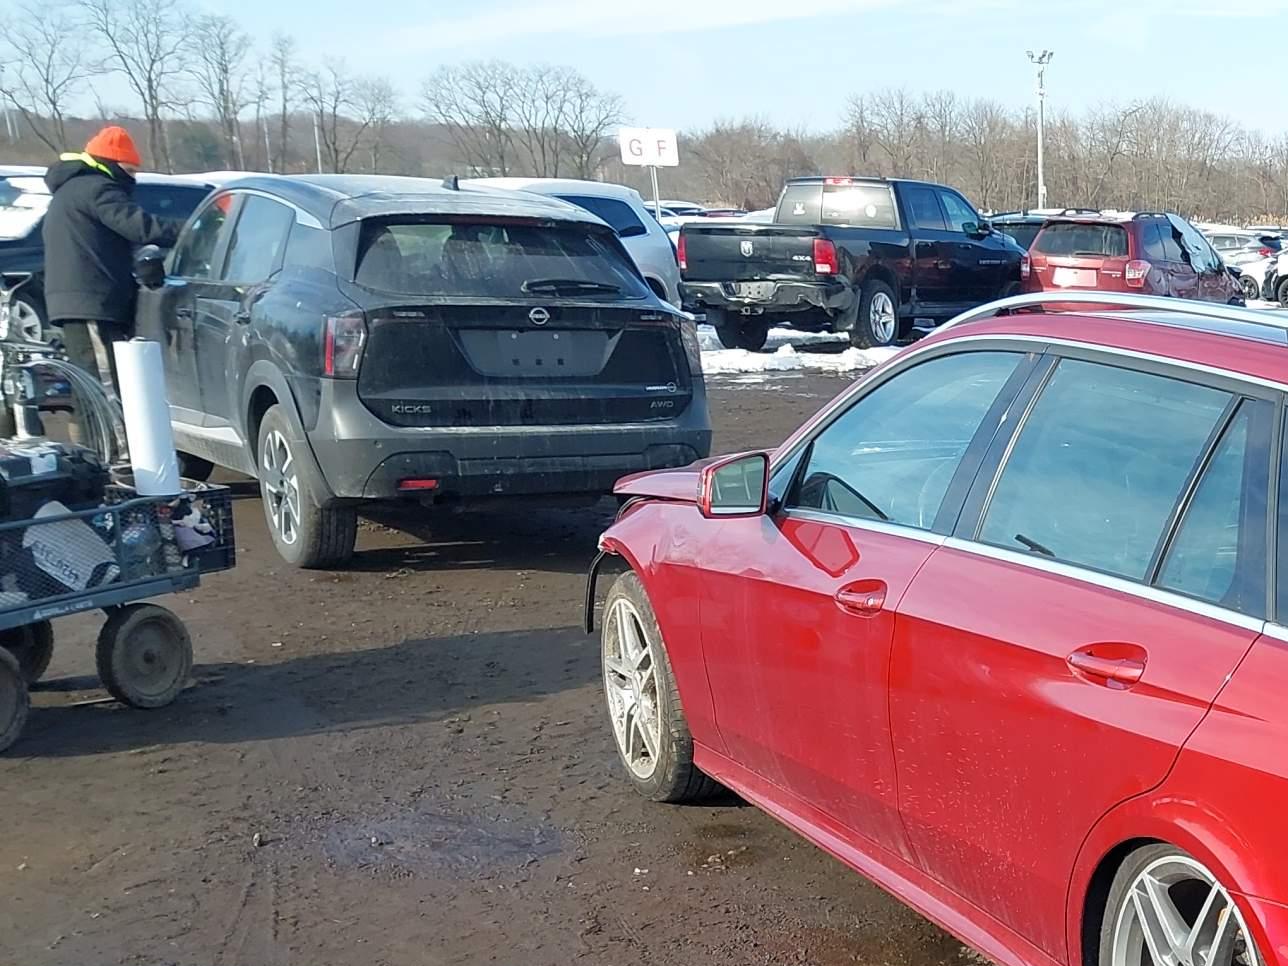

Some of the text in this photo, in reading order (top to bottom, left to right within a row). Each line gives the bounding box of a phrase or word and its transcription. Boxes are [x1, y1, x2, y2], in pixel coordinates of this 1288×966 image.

[629, 138, 667, 157] G F
[391, 404, 432, 414] KICKS
[650, 400, 674, 409] AWD
